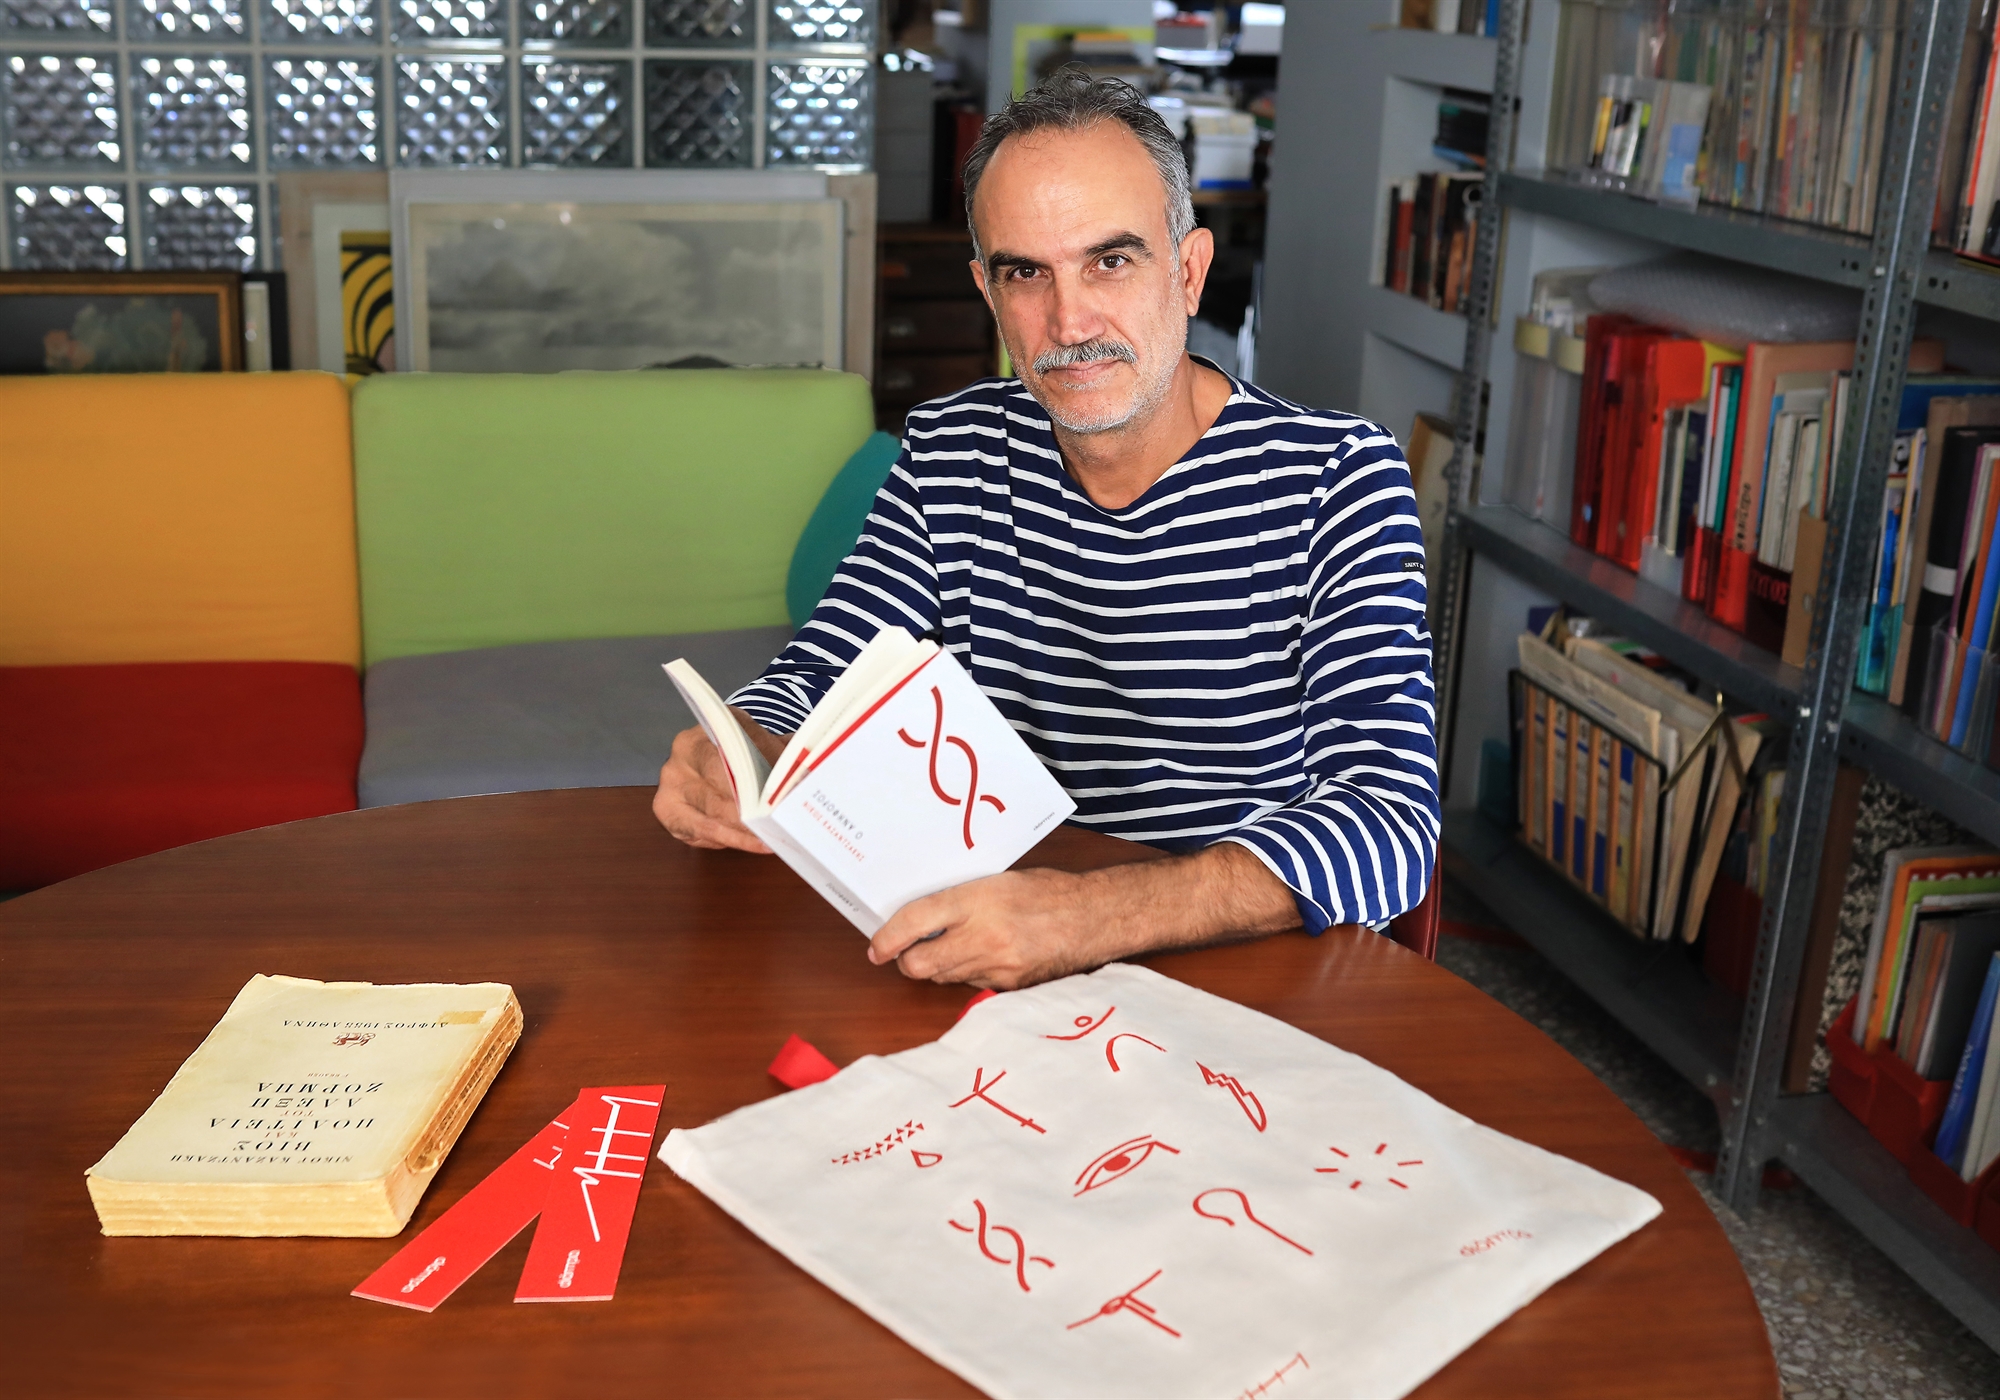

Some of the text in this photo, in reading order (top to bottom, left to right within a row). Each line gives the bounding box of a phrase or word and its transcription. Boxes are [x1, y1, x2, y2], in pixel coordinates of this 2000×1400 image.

[283, 1020, 341, 1029] ΑΘΗΝΑ
[384, 1021, 449, 1029] ΔΙΦΡΟΣ
[257, 1082, 384, 1094] ΖΟΡΜΠΑ
[250, 1097, 362, 1108] ΑΛΕΞΗ
[280, 1109, 315, 1117] ΤΟΥ
[210, 1117, 374, 1130] ΠΟΛΙΤΕΙΑ
[232, 1140, 312, 1151] ΒΙΟΣ
[170, 1154, 354, 1164] ΝΙΚΟΥ ΚΑΖΑΝΤΖΑΚΗ
